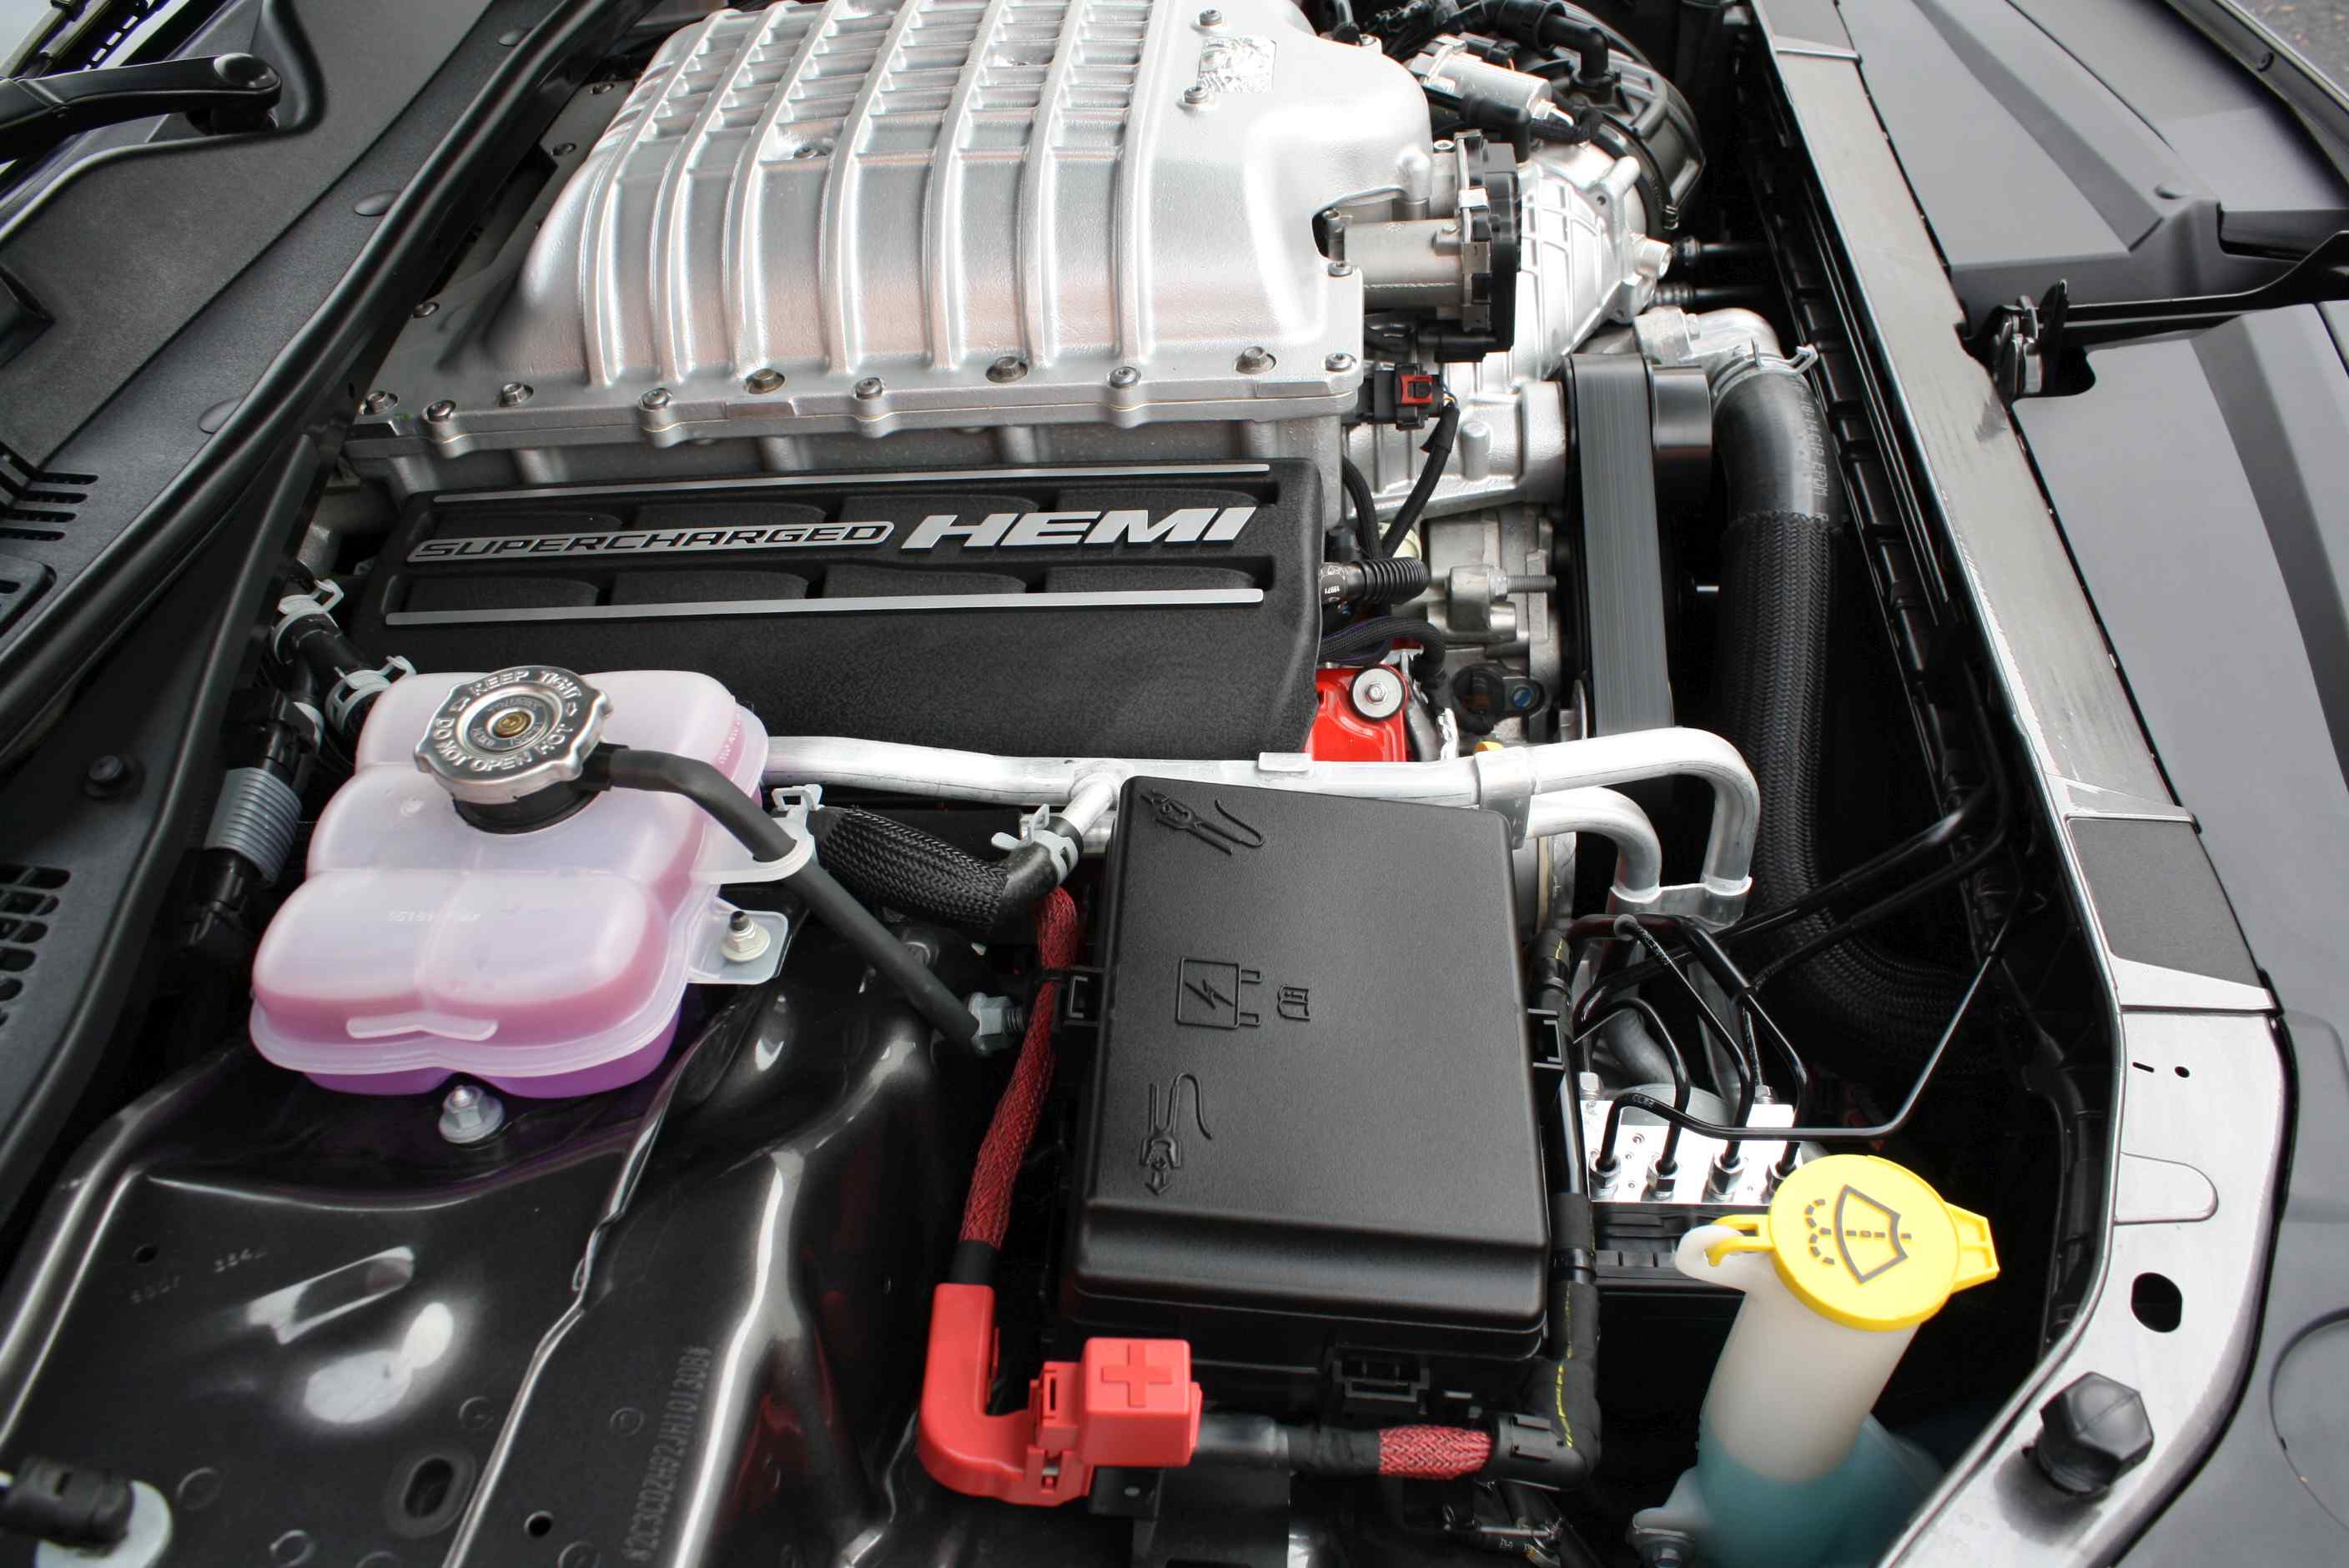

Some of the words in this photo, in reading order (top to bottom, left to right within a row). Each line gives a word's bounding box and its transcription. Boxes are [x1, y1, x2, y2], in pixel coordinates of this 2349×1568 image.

[416, 525, 888, 557] SUPERCHARGED
[900, 506, 1257, 550] HEMI
[470, 670, 530, 696] KEEP
[541, 671, 582, 698] TIGHT
[433, 716, 455, 739] DO
[534, 723, 574, 756] HOT
[435, 739, 471, 766] NOT
[470, 752, 533, 771] OPEN
